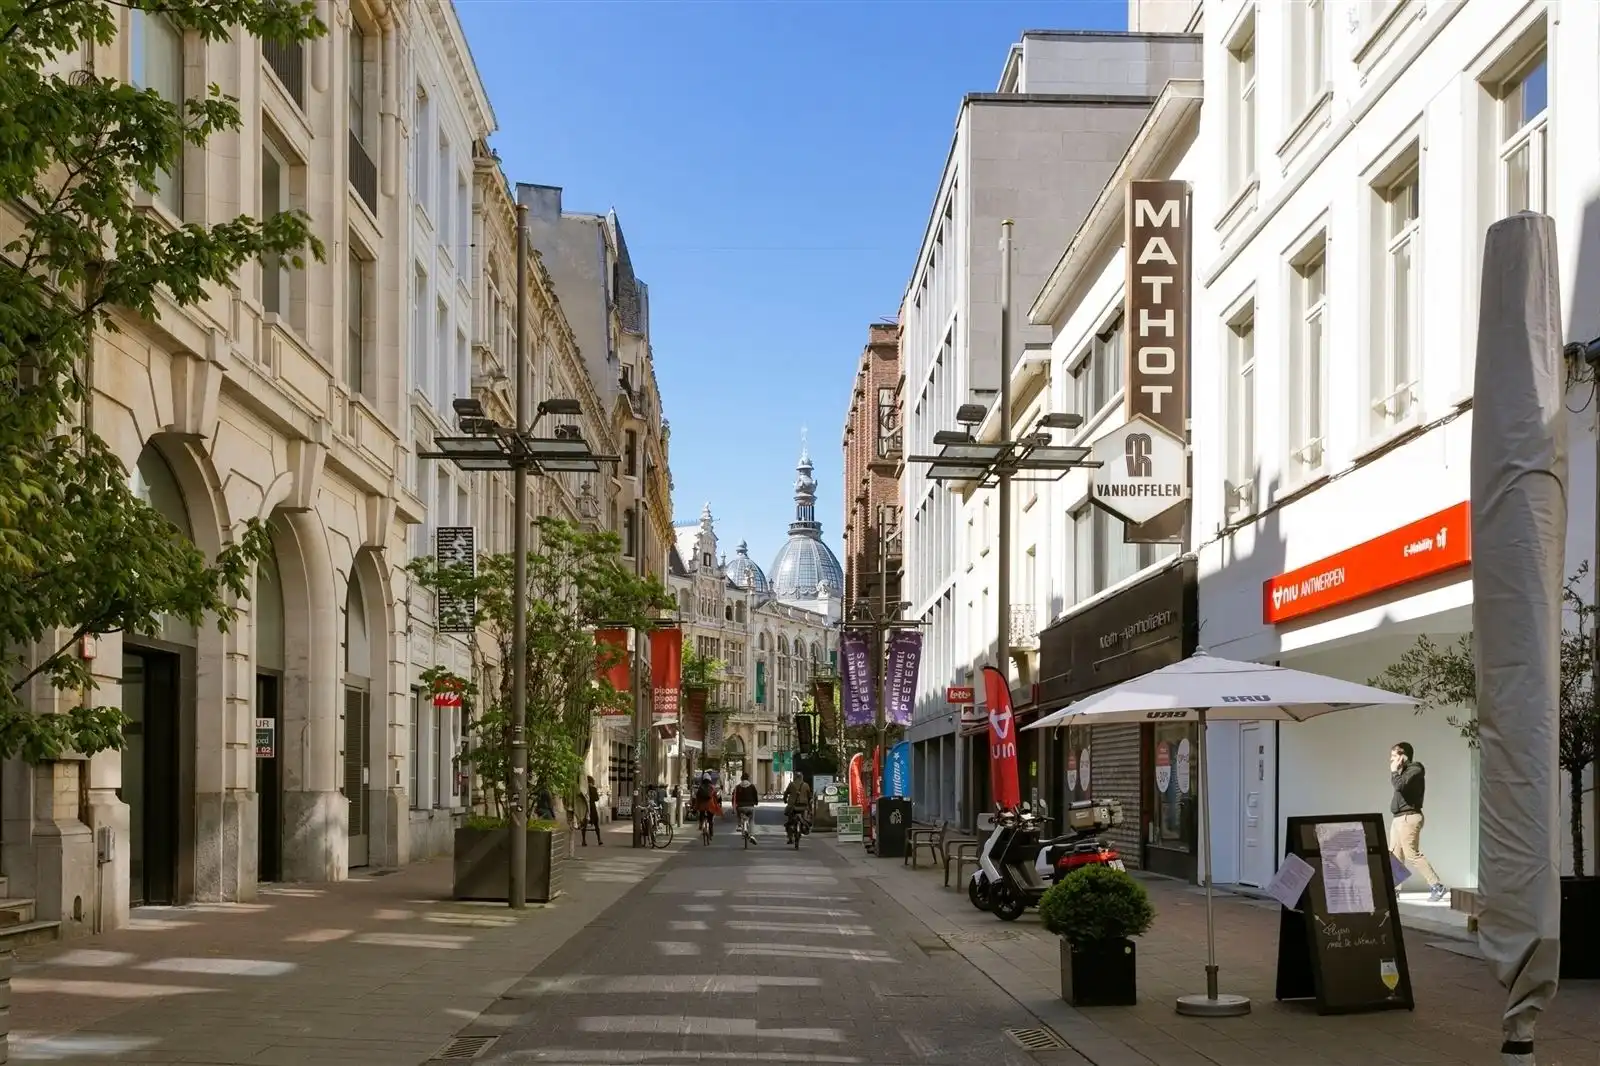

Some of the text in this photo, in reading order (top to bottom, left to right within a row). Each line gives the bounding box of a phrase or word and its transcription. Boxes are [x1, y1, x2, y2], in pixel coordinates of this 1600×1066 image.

[1135, 199, 1180, 413] MATHOT
[1096, 483, 1181, 497] VANHOFFELEN
[1403, 537, 1433, 557] E-Mobility
[1300, 567, 1345, 597] ANTWERPEN
[654, 686, 678, 695] pipoos
[847, 652, 859, 712] KRANTENWINKEL
[857, 651, 870, 711] PEETERS
[891, 651, 905, 711] KRANTENWINKEL
[900, 652, 916, 711] PEETERS
[654, 694, 677, 703] pipoos
[654, 702, 677, 711] pipoos
